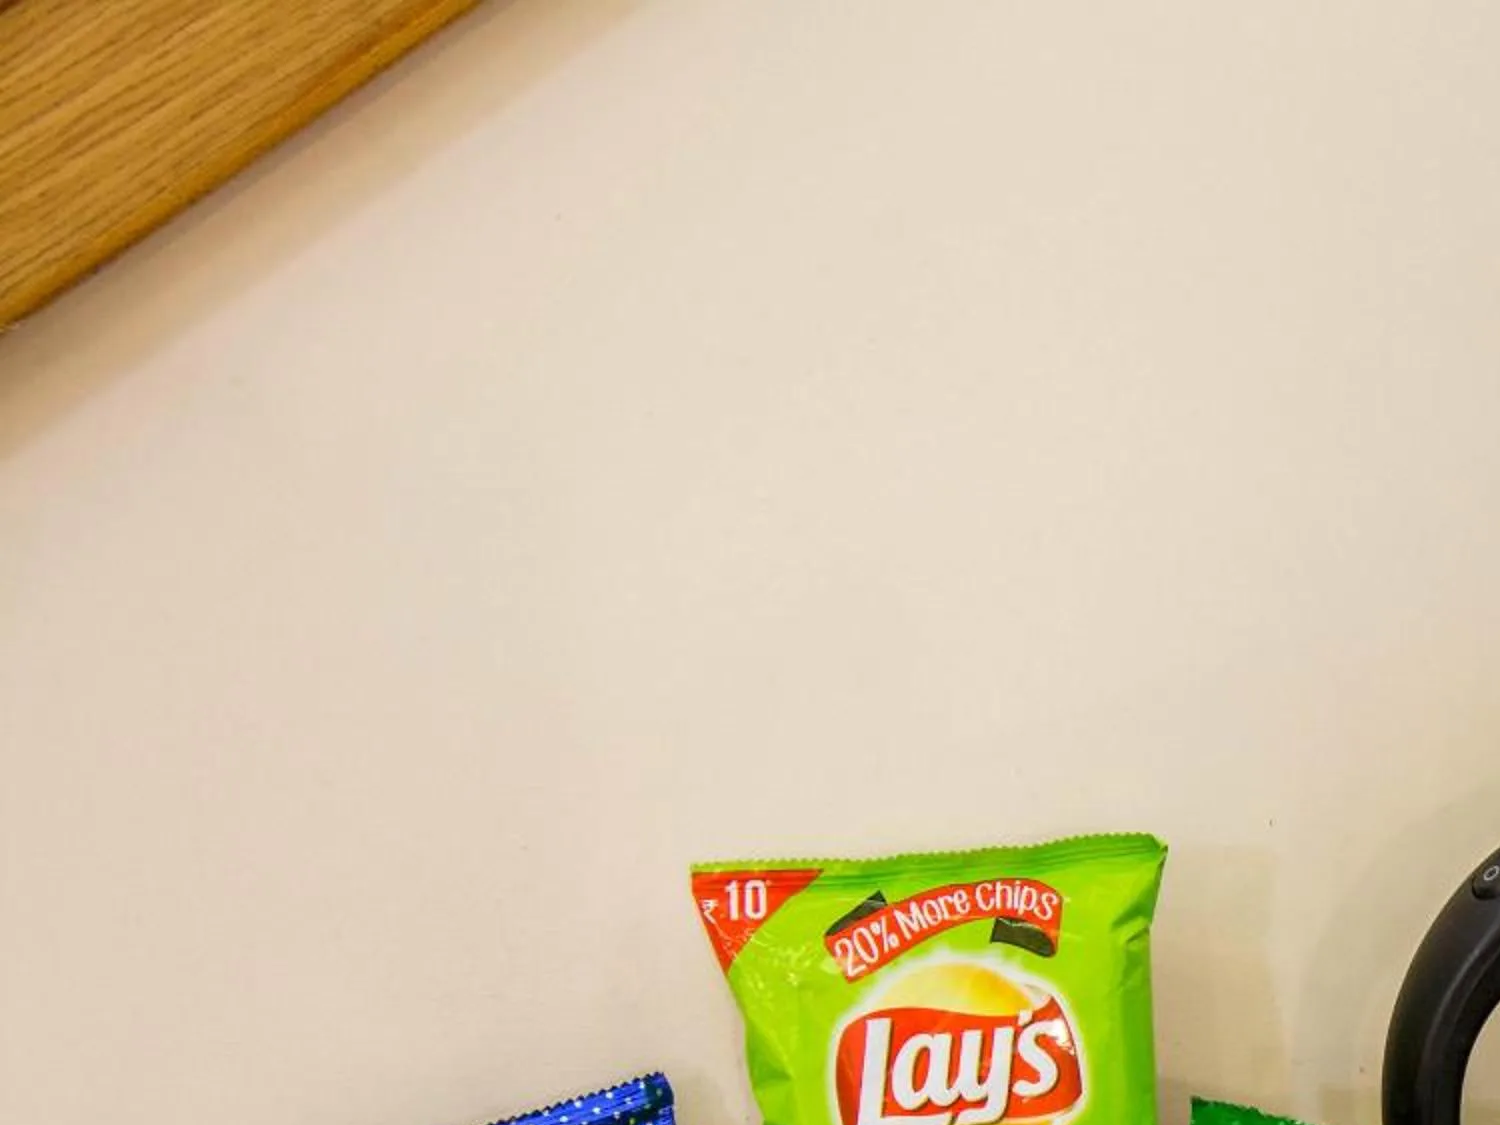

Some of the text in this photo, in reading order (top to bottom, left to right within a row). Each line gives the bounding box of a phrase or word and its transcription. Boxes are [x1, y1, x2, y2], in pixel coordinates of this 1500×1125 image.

[834, 880, 1059, 977] 20% More Chips
